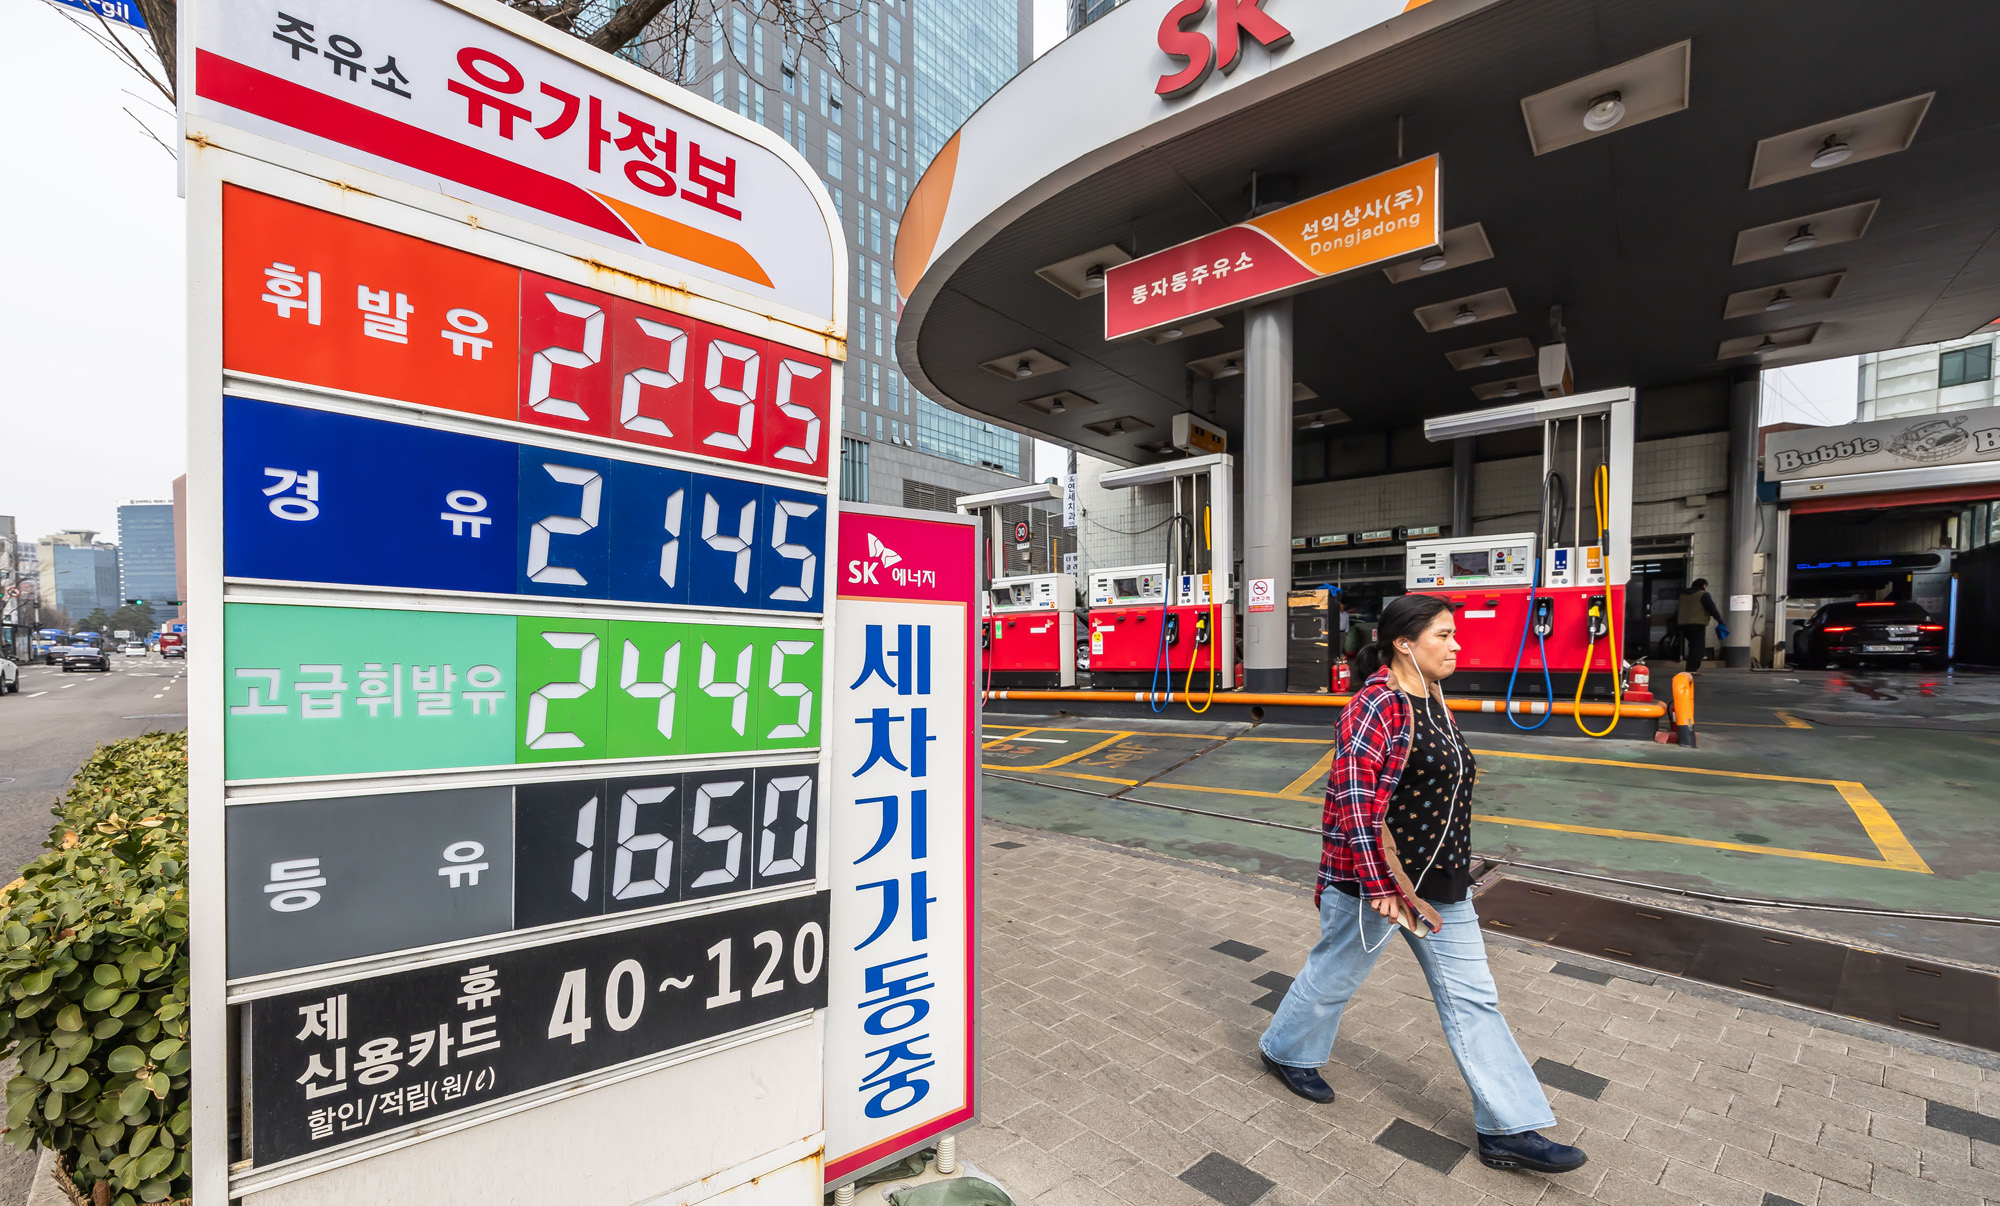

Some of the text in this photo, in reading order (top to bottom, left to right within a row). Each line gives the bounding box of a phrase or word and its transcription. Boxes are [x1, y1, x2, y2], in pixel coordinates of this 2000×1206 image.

[1154, 0, 1292, 97] SK
[273, 11, 743, 222] 주유소 유가정보
[1301, 185, 1424, 241] 선익상사(주)
[1310, 213, 1420, 256] Dongjadong
[1131, 252, 1254, 305] 동자동주유소
[528, 291, 823, 465] 2295
[1776, 437, 1881, 473] Bubble
[527, 462, 819, 602] 2145
[848, 560, 936, 588] SK 에너지
[1017, 527, 1026, 537] 30
[230, 631, 816, 750] 고급휘발유 2445
[571, 775, 813, 902] 1650
[850, 624, 937, 1119] 세차기가동중
[296, 1015, 501, 1100] 신용카드
